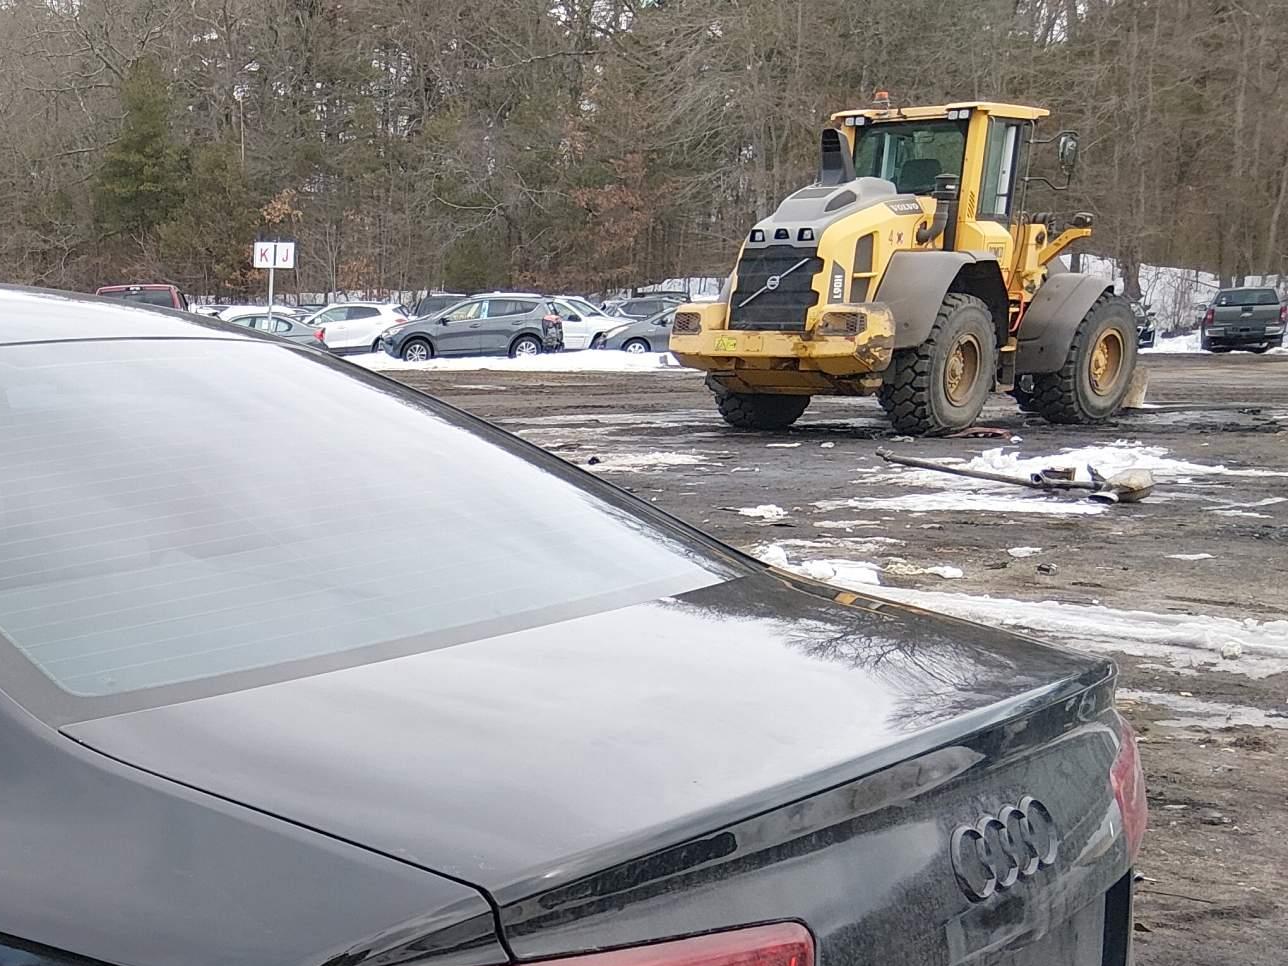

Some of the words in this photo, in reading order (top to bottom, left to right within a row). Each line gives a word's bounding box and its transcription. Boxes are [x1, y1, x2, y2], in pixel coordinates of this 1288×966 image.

[890, 203, 919, 211] VOLVO
[260, 247, 270, 262] K
[282, 248, 289, 262] J
